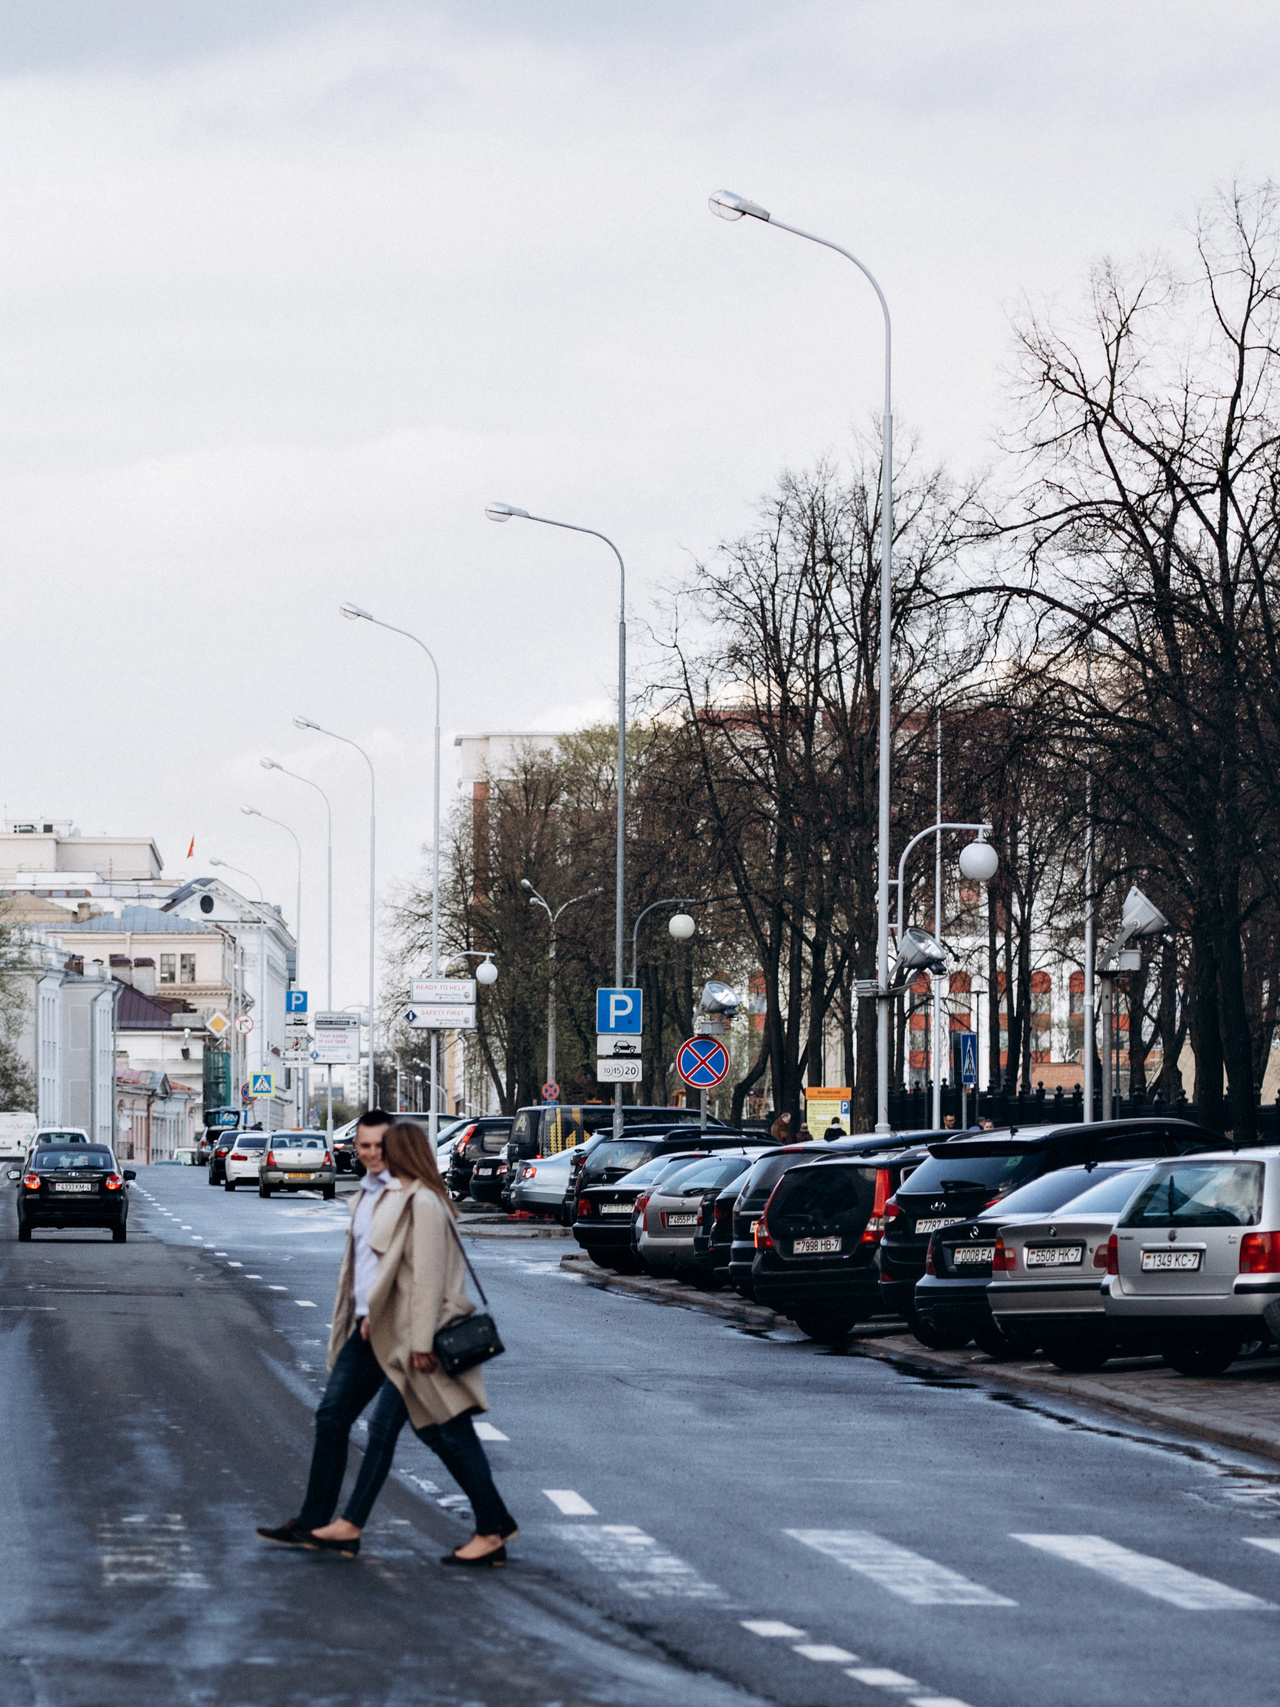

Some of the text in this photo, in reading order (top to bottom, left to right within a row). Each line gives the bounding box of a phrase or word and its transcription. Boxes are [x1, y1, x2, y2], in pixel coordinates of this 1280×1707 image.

[291, 993, 304, 1011] P
[609, 994, 633, 1028] P
[624, 1066, 637, 1075] 20
[842, 1102, 849, 1113] P
[686, 1214, 698, 1223] PT-
[923, 1220, 942, 1231] 7787
[801, 1239, 840, 1251] 7998 HB-7
[961, 1248, 993, 1260] 0008 EA
[1035, 1248, 1080, 1262] 5508 HK-7
[1152, 1253, 1198, 1267] 1349 KC-7
